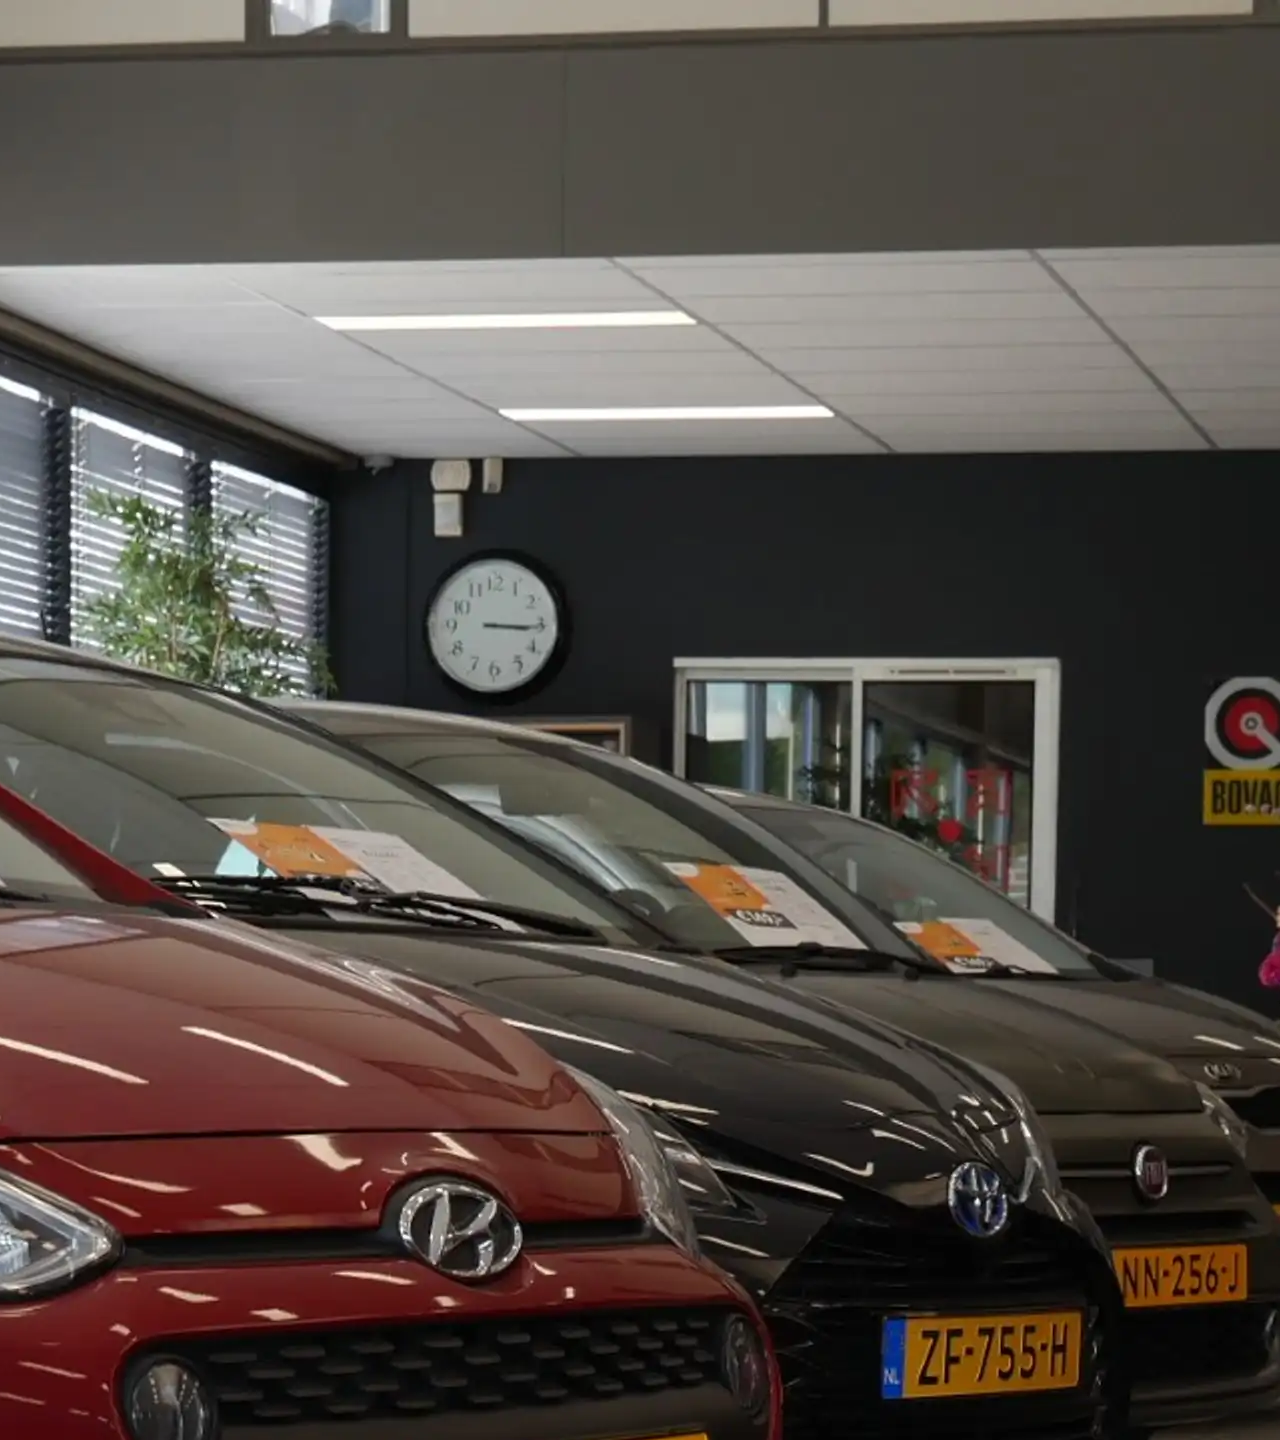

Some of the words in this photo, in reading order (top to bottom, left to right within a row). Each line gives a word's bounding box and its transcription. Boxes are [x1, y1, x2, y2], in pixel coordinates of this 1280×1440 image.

[1122, 1251, 1240, 1299] NN-256-J
[883, 1367, 900, 1385] NL
[918, 1322, 1068, 1386] ZF-755-H
